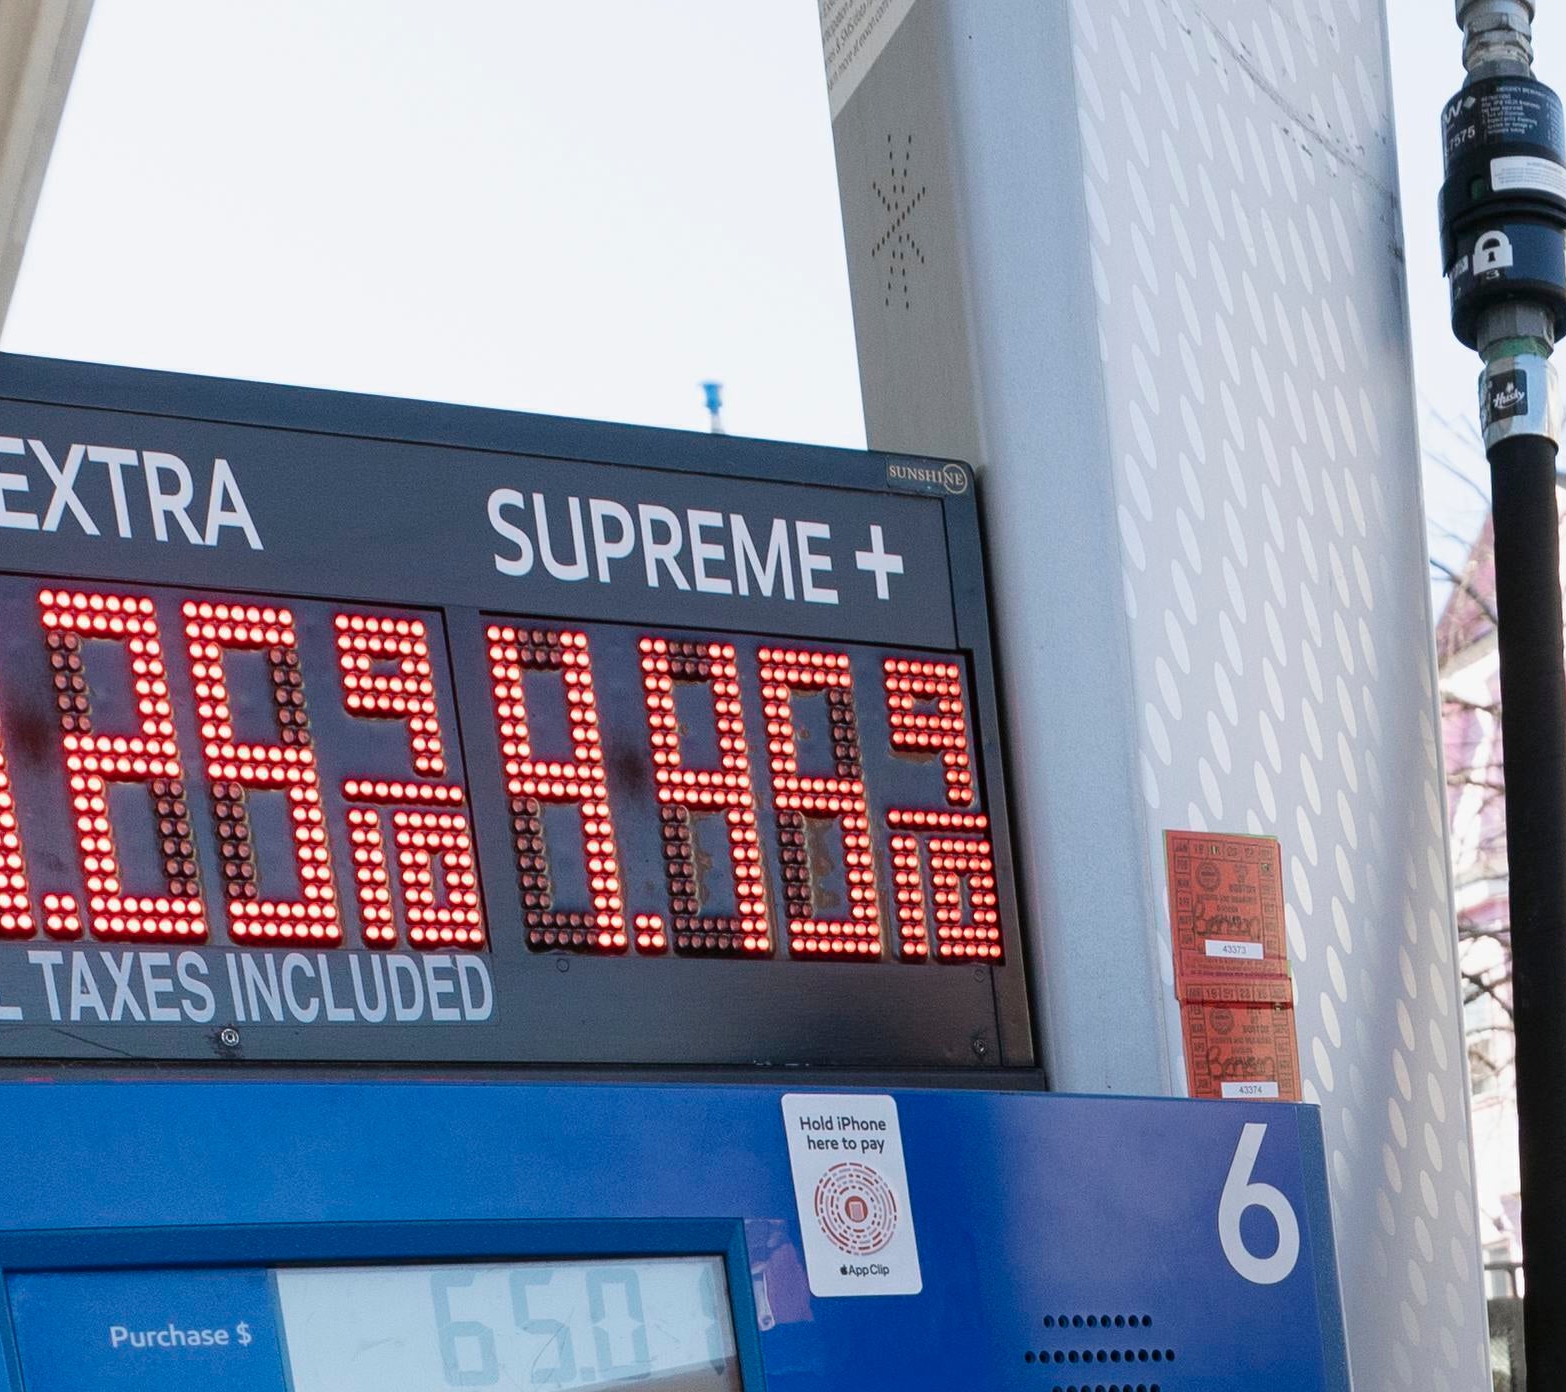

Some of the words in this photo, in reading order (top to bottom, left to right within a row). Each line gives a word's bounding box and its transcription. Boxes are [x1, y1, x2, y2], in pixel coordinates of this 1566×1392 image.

[1493, 388, 1525, 410] Husky
[888, 464, 966, 489] SUNSHINE
[487, 488, 839, 605] SUPREME
[28, 950, 216, 1020] TAXES
[227, 952, 495, 1022] INCLUDED
[800, 1116, 834, 1133] Hold
[837, 1115, 886, 1133] iPhone
[808, 1135, 838, 1152] here
[842, 1135, 856, 1151] to
[861, 1137, 885, 1154] pay
[1218, 1123, 1301, 1285] 6
[849, 1265, 868, 1278] App
[870, 1264, 889, 1277] Clip
[110, 1321, 229, 1350] Purchase
